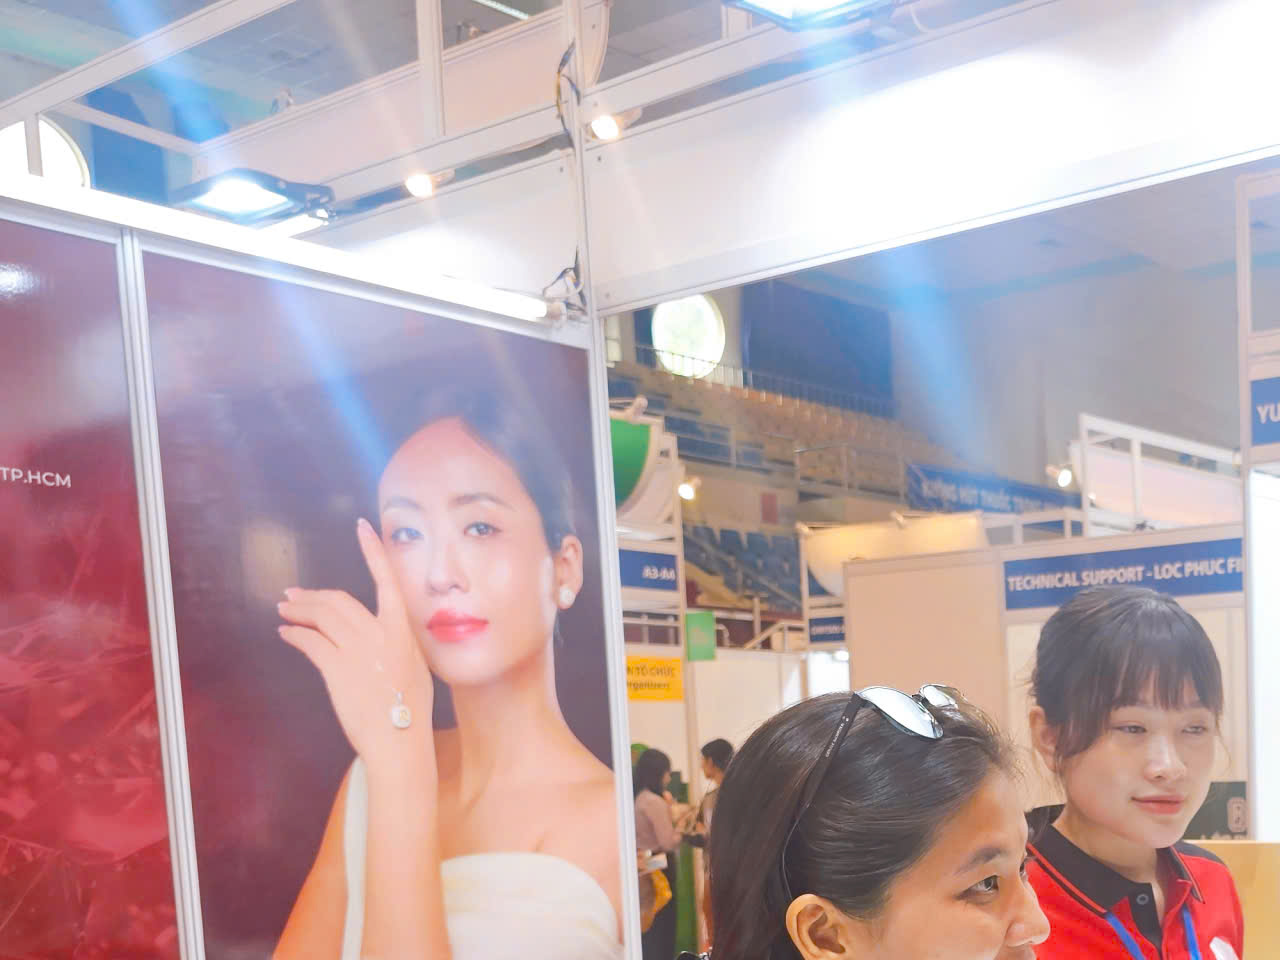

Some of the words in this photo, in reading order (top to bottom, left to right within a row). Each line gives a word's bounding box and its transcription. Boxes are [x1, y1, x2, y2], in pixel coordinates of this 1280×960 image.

[0, 466, 72, 489] TP.HCM
[1007, 570, 1079, 592] TECHNICAL
[1083, 565, 1145, 587] SUPPORT
[1154, 561, 1182, 580] LOC
[1184, 559, 1226, 577] PHUC
